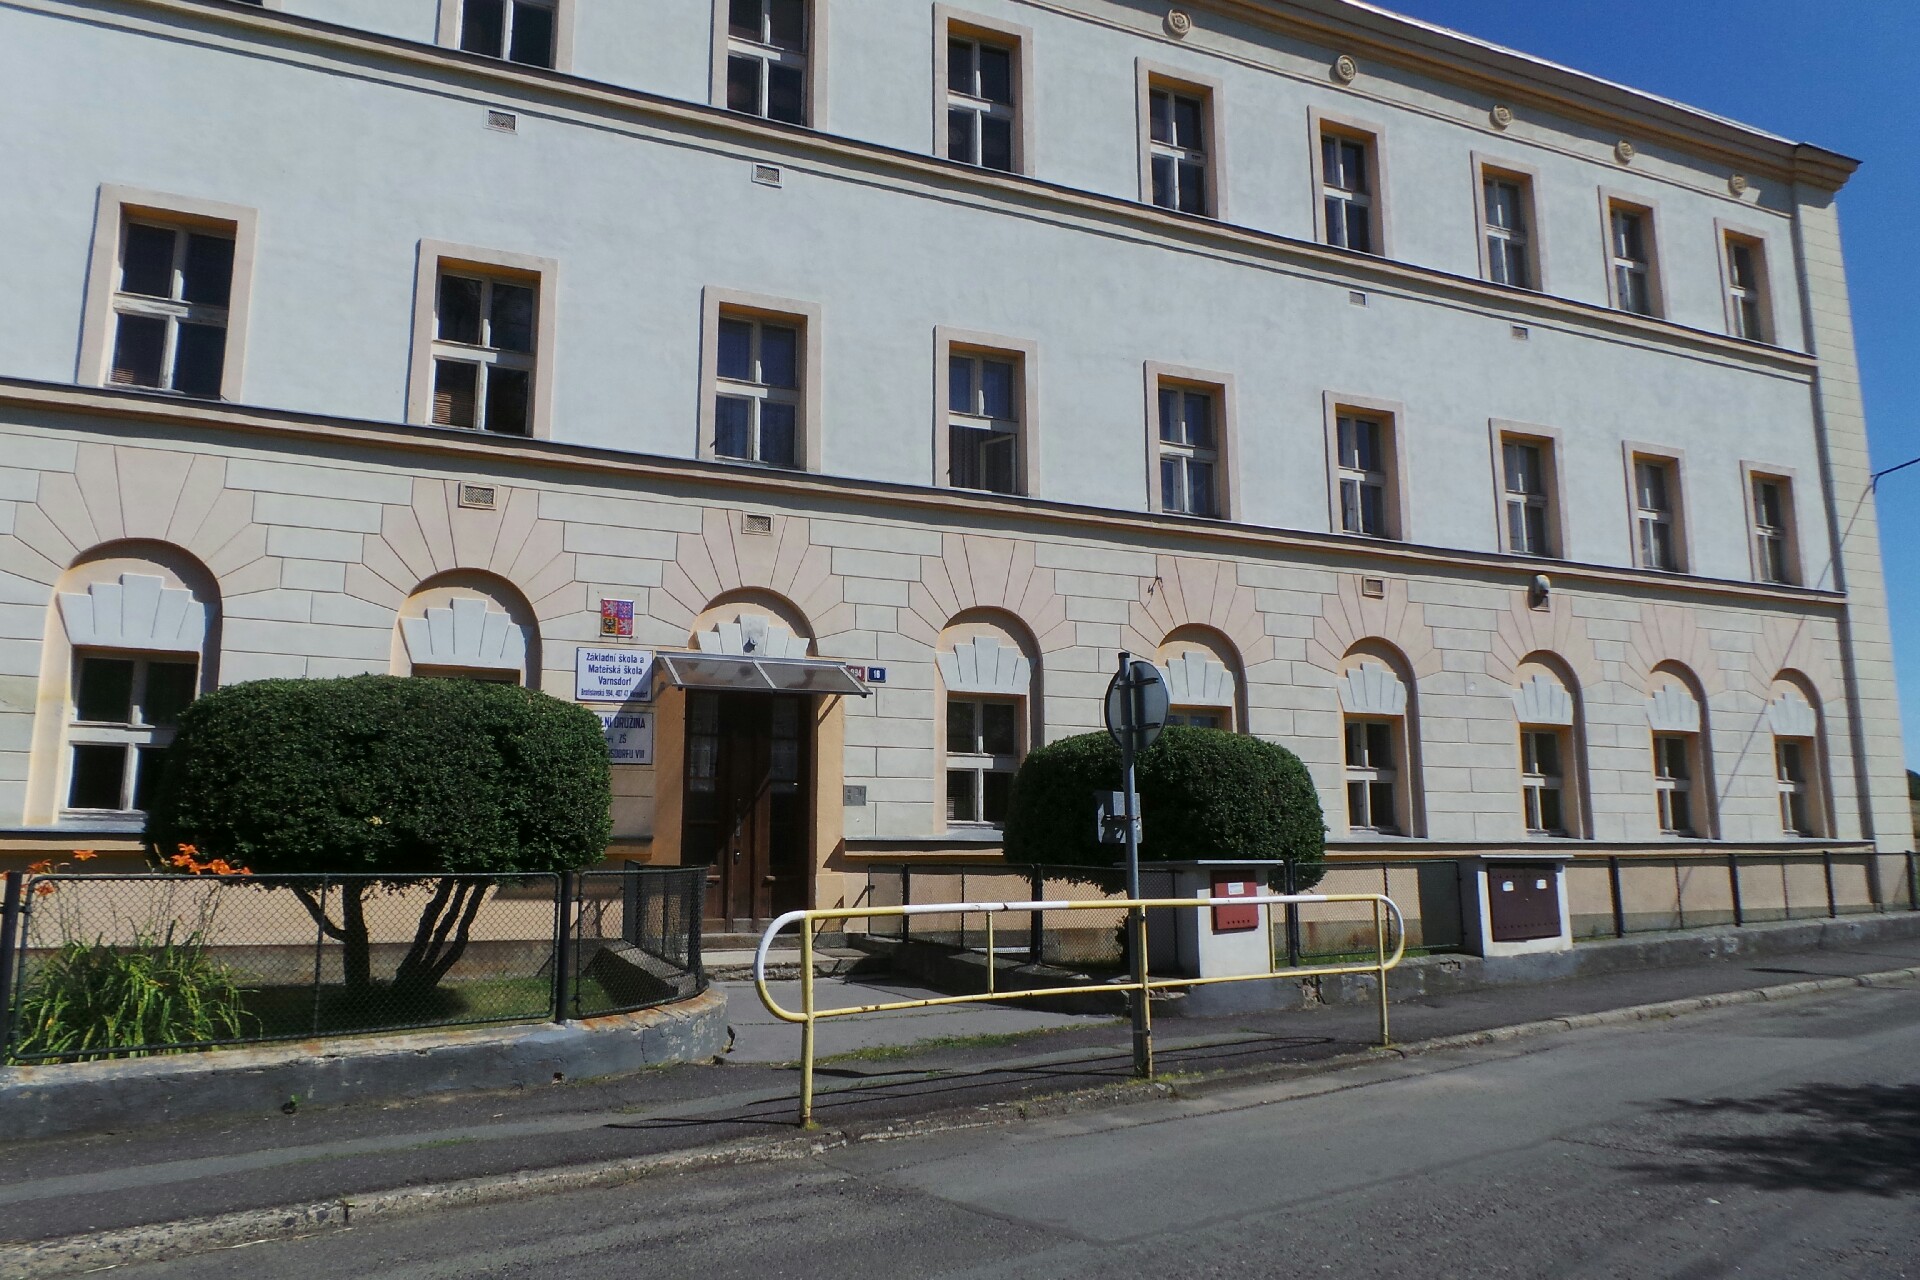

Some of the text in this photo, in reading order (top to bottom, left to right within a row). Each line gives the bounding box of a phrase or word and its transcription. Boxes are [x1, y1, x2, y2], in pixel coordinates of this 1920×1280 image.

[586, 653, 616, 662] Základní
[619, 654, 638, 663] škola
[588, 664, 642, 674] Mateřská škola
[598, 676, 632, 685] Varnsdorf
[614, 716, 645, 728] DRUŽINA
[619, 733, 627, 743] ZŠ
